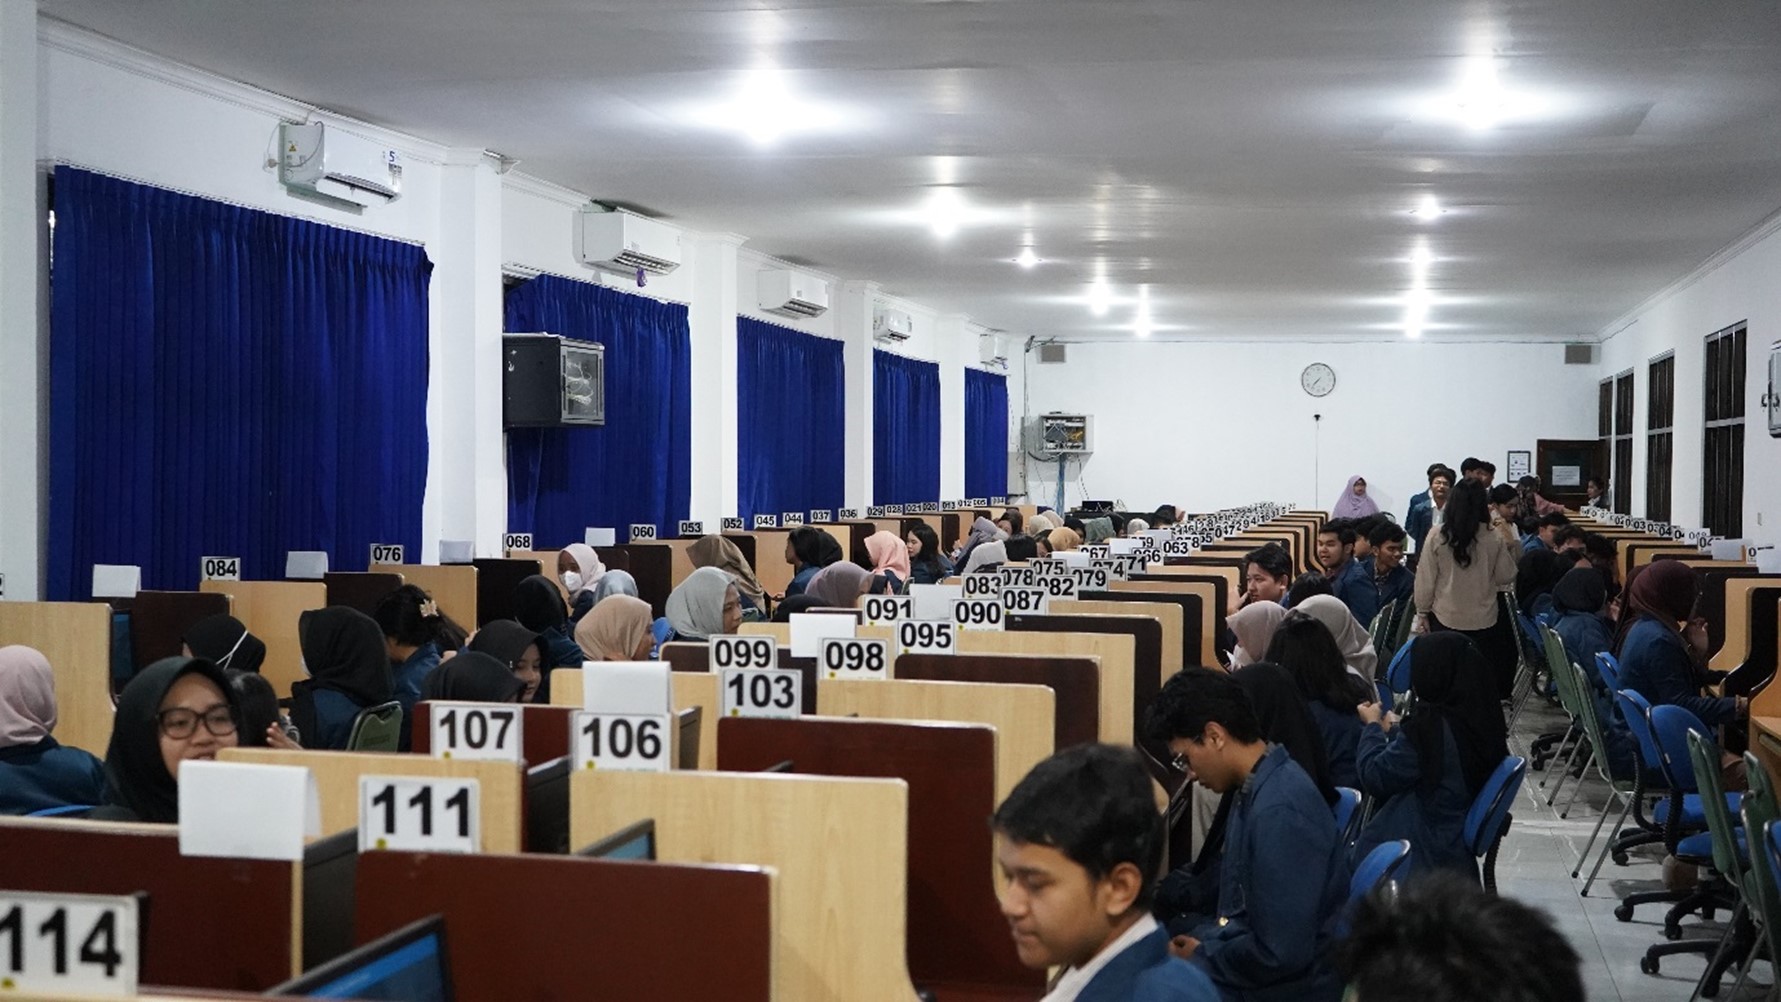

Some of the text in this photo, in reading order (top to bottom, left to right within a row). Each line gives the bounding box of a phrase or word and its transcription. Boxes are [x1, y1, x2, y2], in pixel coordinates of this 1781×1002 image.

[840, 509, 857, 518] 036
[867, 507, 883, 516] 029
[906, 504, 922, 512] 021
[922, 503, 936, 511] 020
[723, 518, 743, 530] 052
[756, 516, 775, 526] 045
[784, 513, 802, 524] 044
[812, 511, 829, 521] 037
[633, 526, 654, 538] 060
[681, 522, 701, 534] 053
[506, 535, 531, 549] 068
[1163, 540, 1189, 554] 063
[373, 546, 401, 562] 076
[205, 558, 237, 577] 084
[1033, 560, 1065, 575] 075
[1116, 555, 1146, 571] 71
[965, 576, 1000, 595] 083
[1003, 589, 1044, 611] 087
[866, 598, 912, 621] 091
[955, 601, 1001, 624] 090
[900, 622, 952, 649] 095
[715, 639, 771, 668] 099
[825, 641, 884, 672] 098
[728, 673, 795, 709] 103
[439, 709, 514, 750] 107
[583, 717, 662, 760] 106
[372, 784, 469, 837] 111
[0, 906, 122, 977] 114
